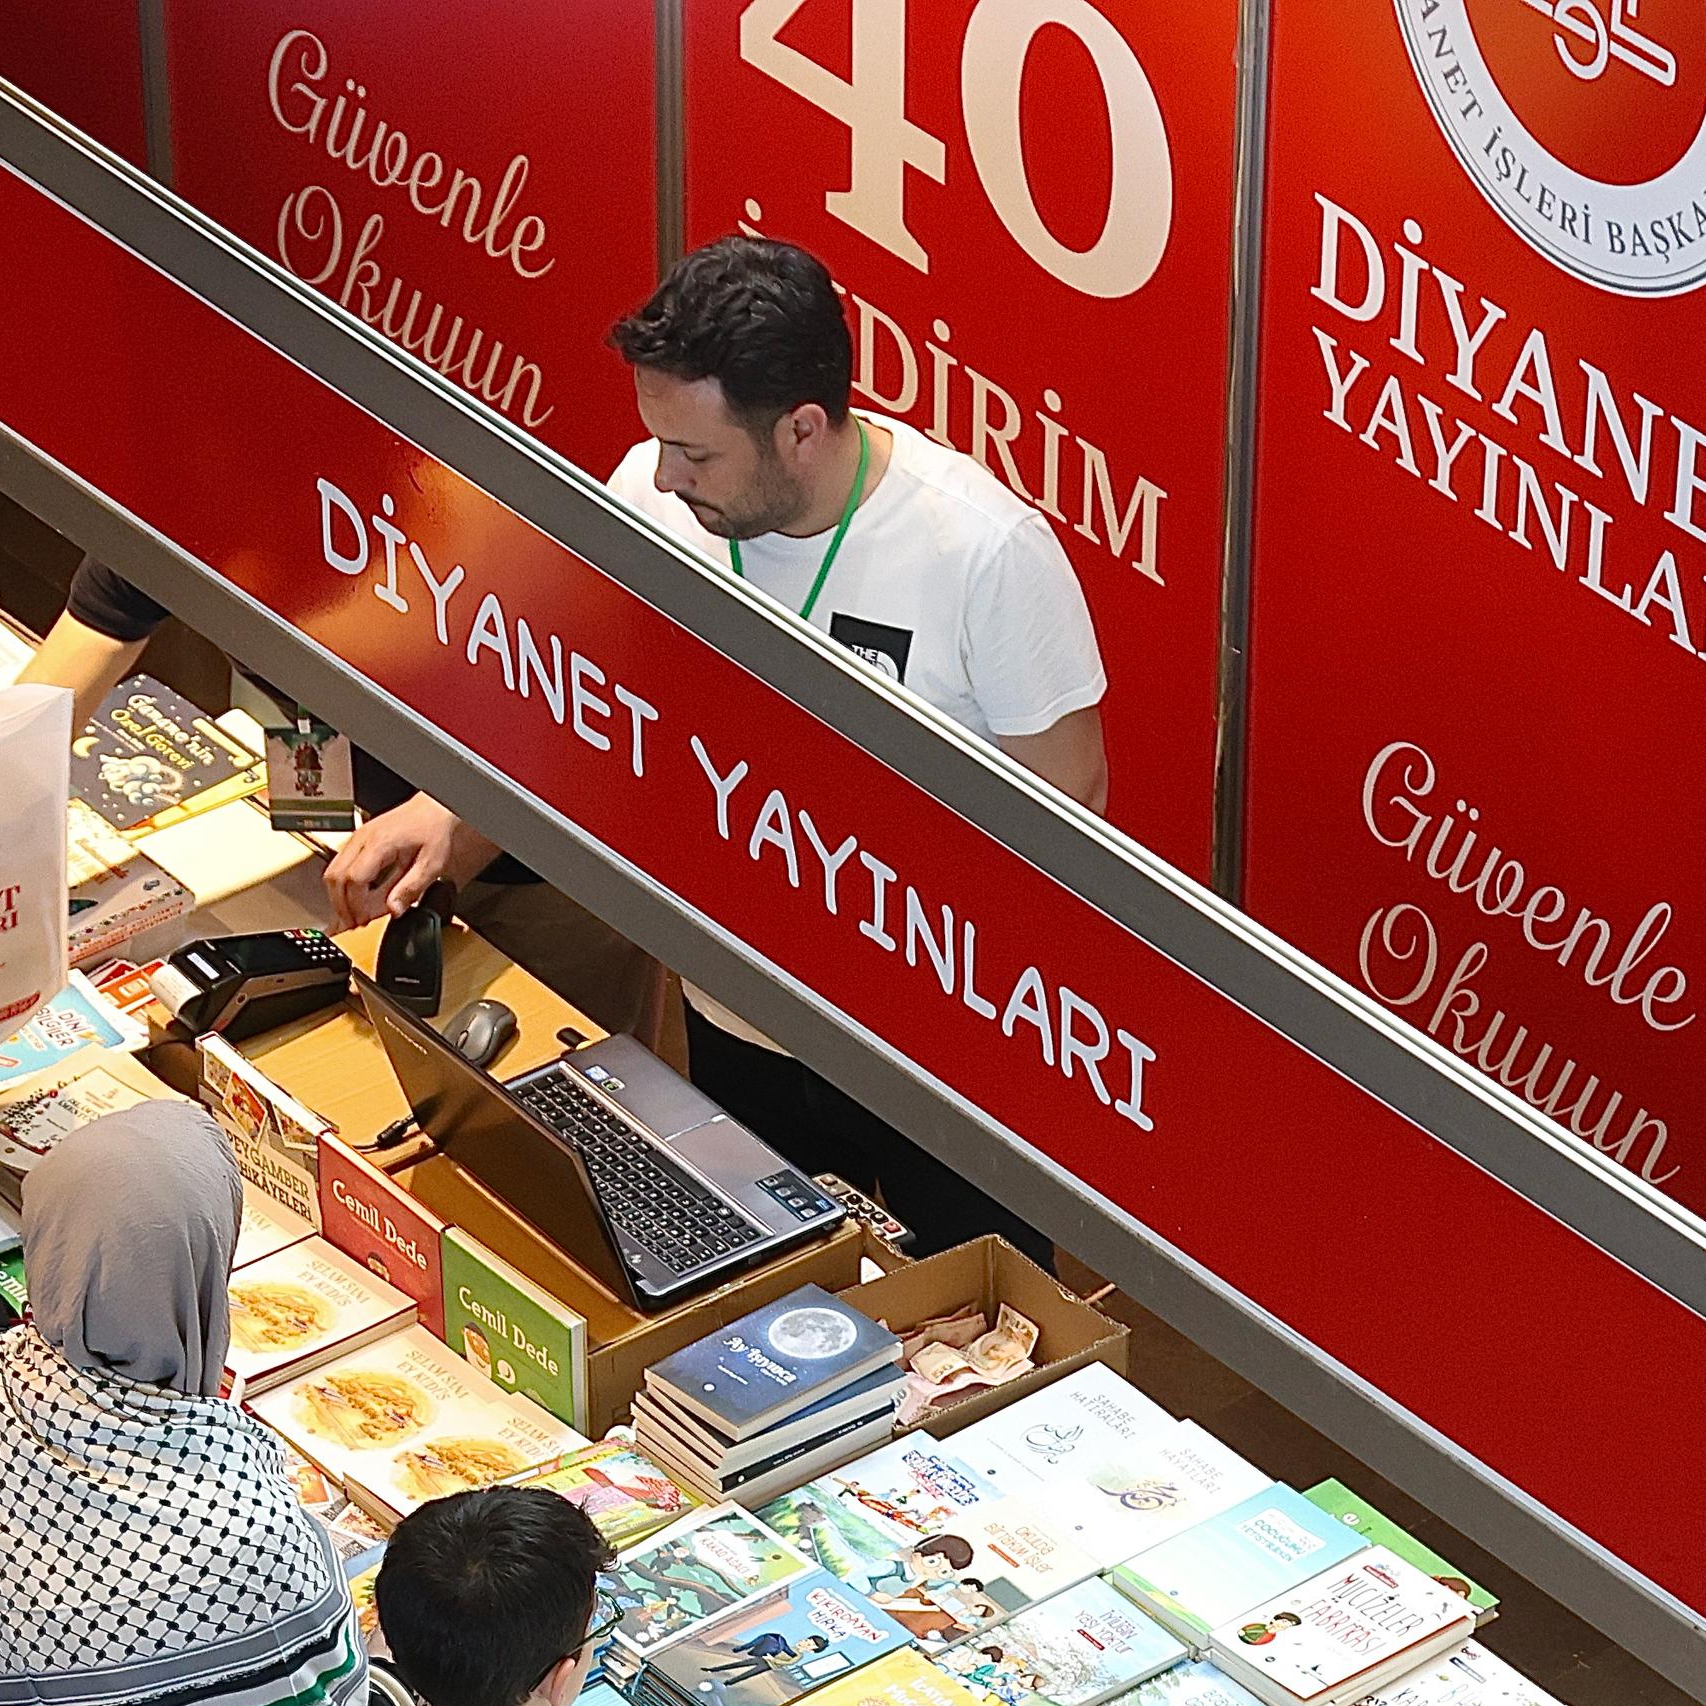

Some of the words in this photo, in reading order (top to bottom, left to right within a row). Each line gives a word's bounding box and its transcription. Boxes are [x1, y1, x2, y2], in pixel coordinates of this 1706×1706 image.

[268, 29, 555, 279] Güvenle
[739, 0, 1172, 299] 40
[1482, 127, 1593, 245] İŞLERİ
[317, 480, 658, 777] DİYANET
[691, 735, 1156, 1132] YAYINLARI
[1362, 741, 1695, 1031] Güvenle
[332, 1179, 380, 1233] Cemil
[383, 1215, 429, 1272] Dede
[458, 1286, 508, 1339] Cemil
[511, 1324, 559, 1377] Dede
[811, 1590, 883, 1641] KIKIRDAYAN
[811, 1610, 847, 1638] HIRKA
